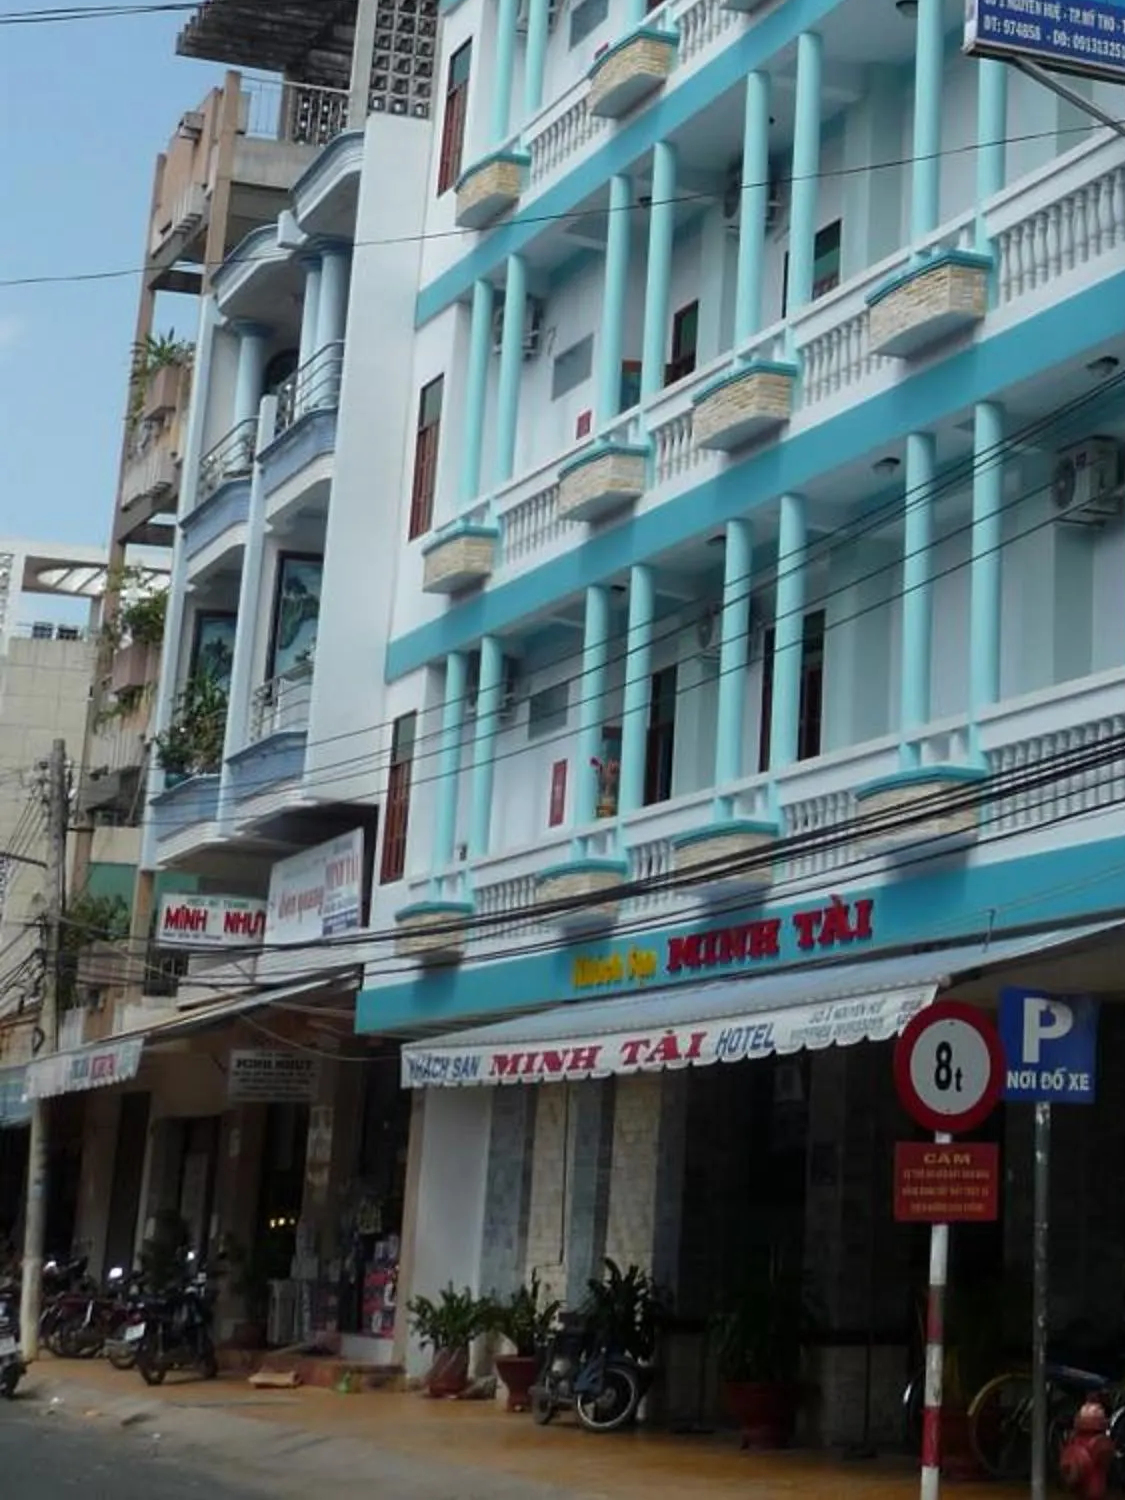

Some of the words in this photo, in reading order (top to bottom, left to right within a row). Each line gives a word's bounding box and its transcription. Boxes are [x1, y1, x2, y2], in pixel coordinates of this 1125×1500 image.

[666, 918, 781, 974] MINH
[793, 894, 875, 949] TÀI
[489, 1046, 603, 1076] MINH
[715, 1023, 775, 1056] HOTEL
[1022, 998, 1073, 1063] P
[1068, 1072, 1091, 1092] XE
